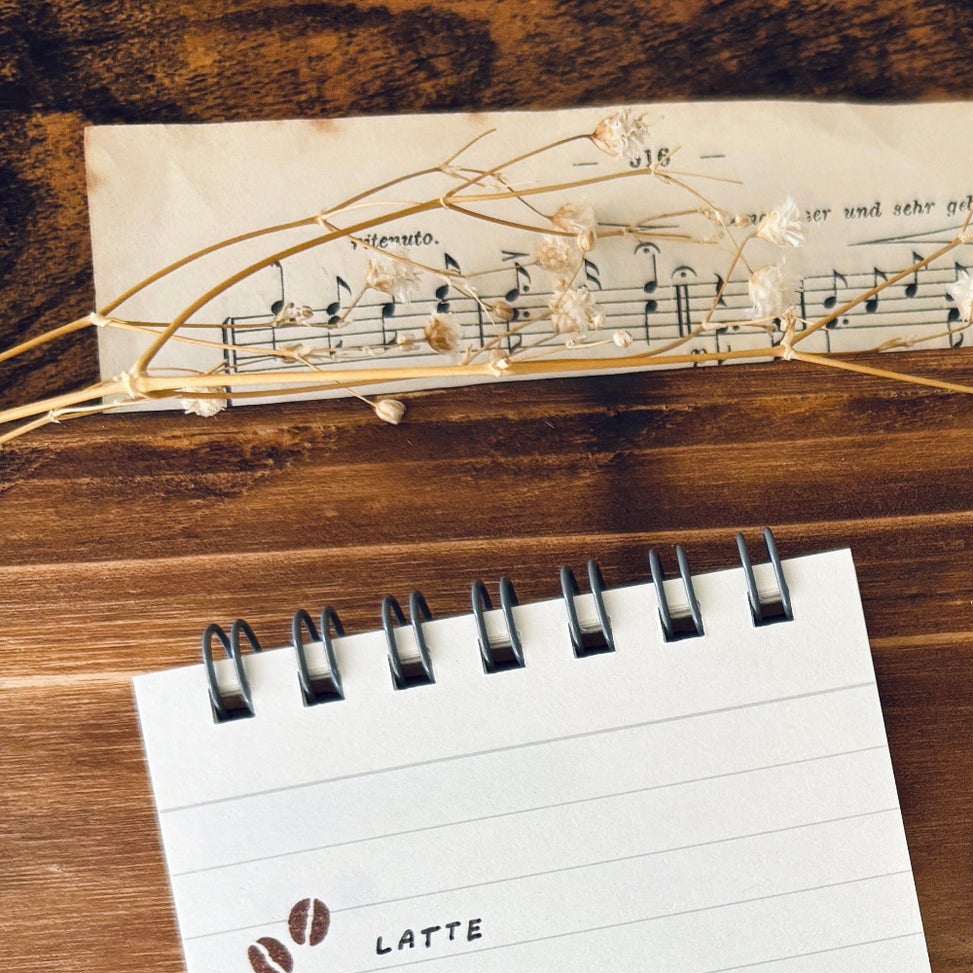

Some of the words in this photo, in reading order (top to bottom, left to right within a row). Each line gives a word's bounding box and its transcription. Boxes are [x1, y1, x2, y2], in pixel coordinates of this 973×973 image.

[844, 201, 882, 219] und
[893, 199, 935, 217] sehr
[376, 918, 482, 955] LATTE
